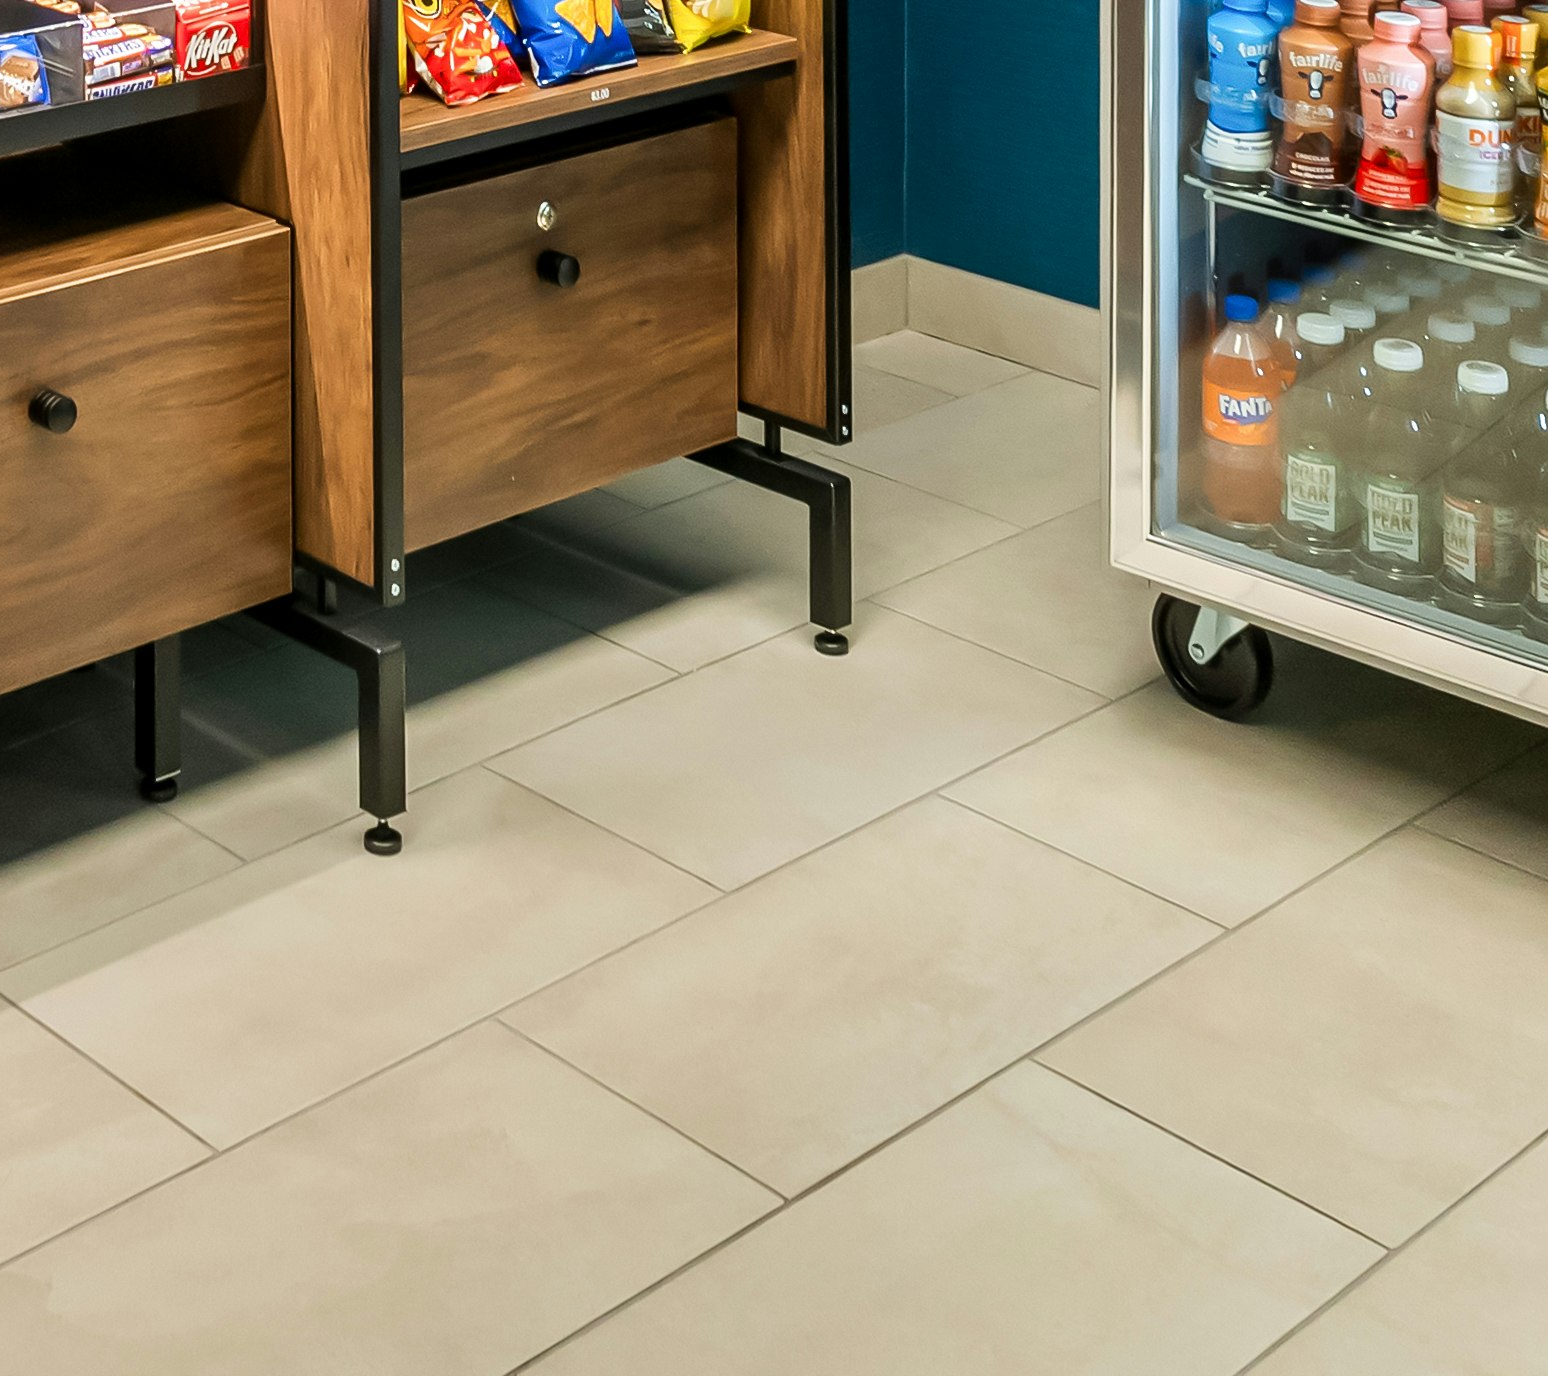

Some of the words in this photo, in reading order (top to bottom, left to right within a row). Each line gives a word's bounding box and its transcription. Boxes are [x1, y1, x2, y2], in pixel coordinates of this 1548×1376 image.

[185, 24, 238, 70] KitKat
[1288, 51, 1344, 73] fairlife
[1289, 459, 1331, 488] GOLD
[1289, 480, 1331, 504] PEAK
